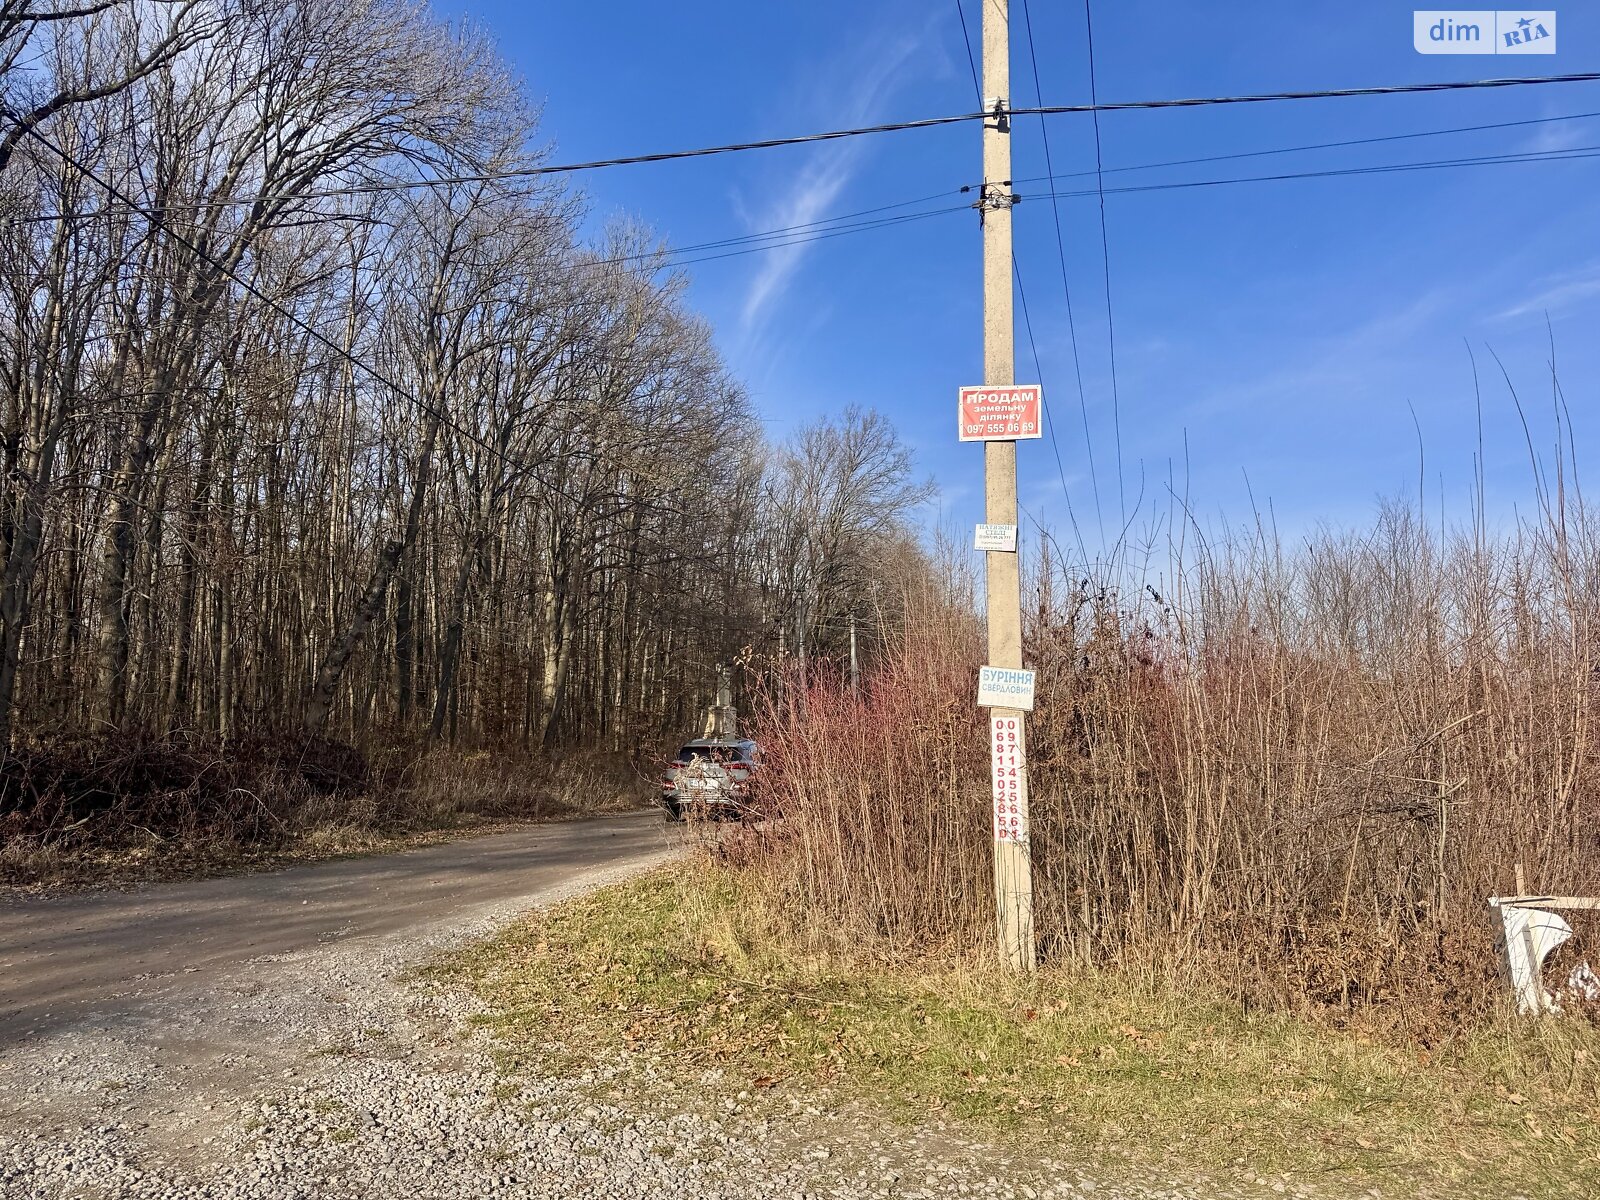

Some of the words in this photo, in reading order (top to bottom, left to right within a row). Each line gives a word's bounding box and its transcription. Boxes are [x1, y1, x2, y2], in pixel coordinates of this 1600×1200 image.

[966, 392, 1034, 404] ПРОДАМ
[974, 404, 1026, 412] земельну
[979, 413, 1021, 422] ділянку
[967, 424, 984, 434] 097
[987, 423, 1004, 433] 555
[1007, 423, 1019, 432] 06
[1022, 421, 1034, 431] 69
[982, 669, 1033, 685] БУРІННЯ
[982, 683, 1032, 695] СВЕРДЛОВИН
